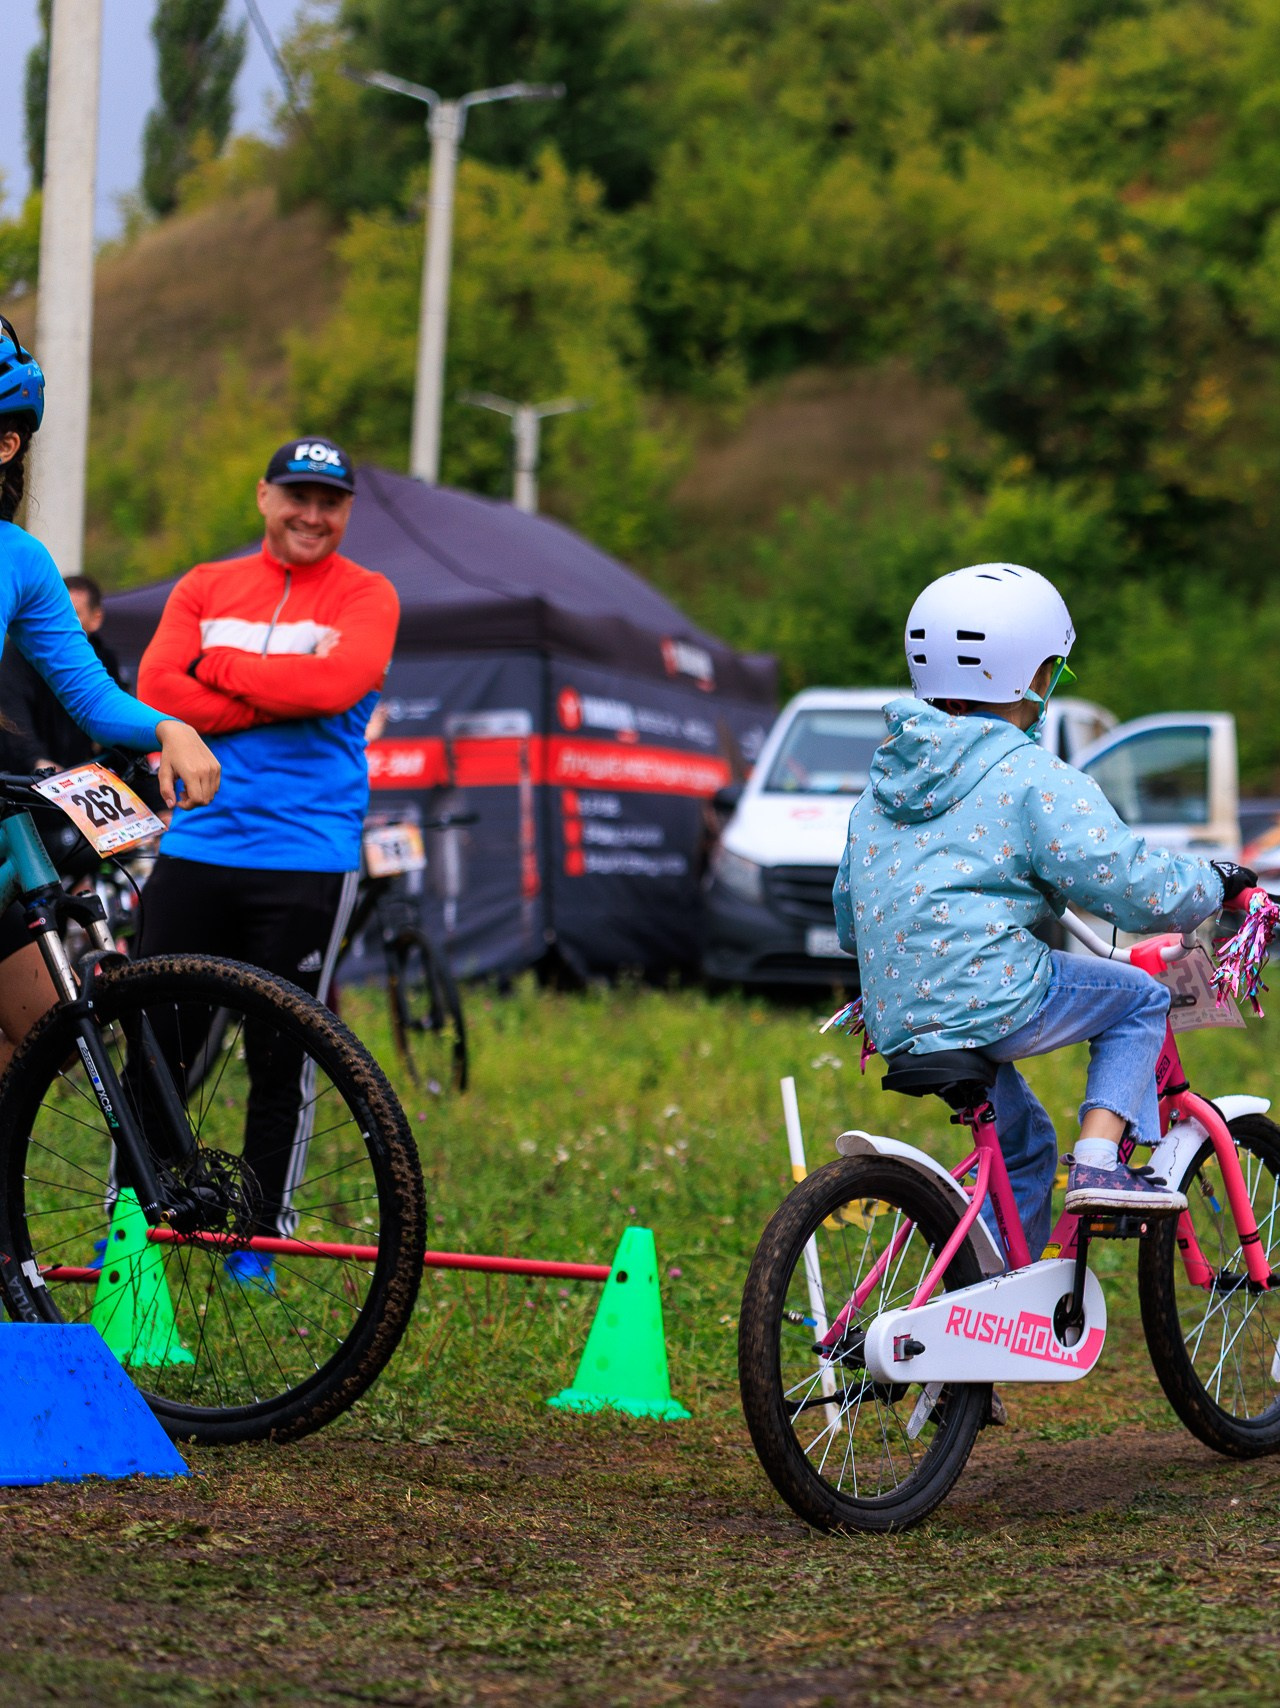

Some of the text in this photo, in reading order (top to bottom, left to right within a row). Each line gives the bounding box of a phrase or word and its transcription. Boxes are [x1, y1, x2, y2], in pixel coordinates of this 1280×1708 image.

[294, 443, 341, 467] FOX
[71, 784, 136, 828] 262
[945, 1305, 1015, 1348] RUSH
